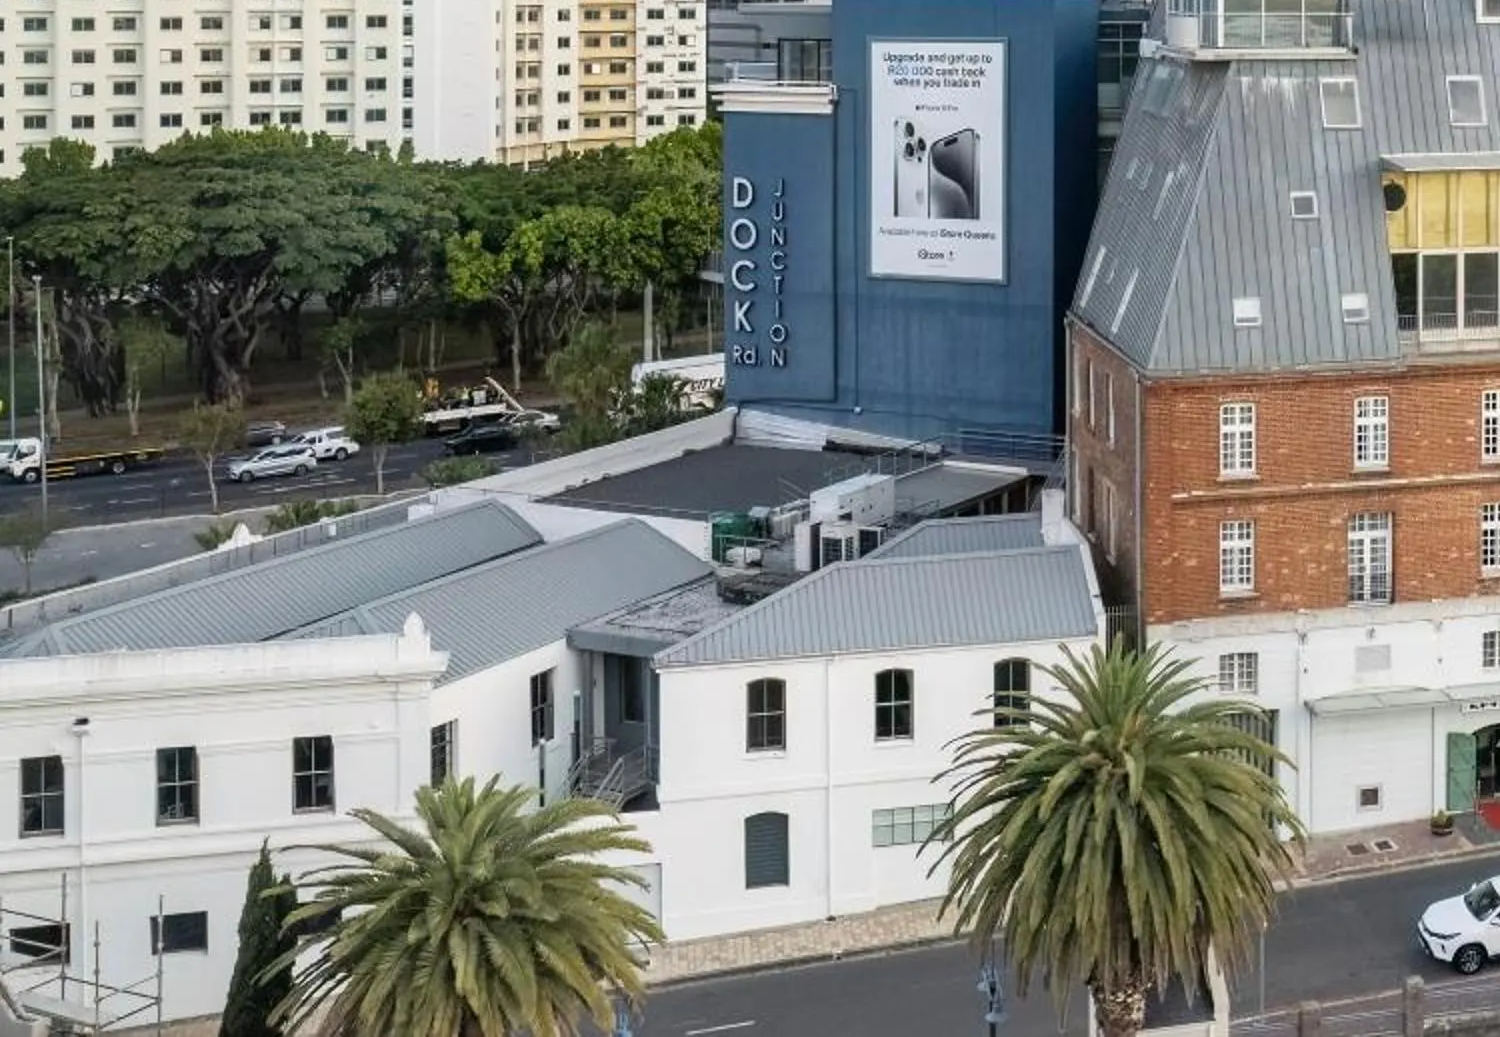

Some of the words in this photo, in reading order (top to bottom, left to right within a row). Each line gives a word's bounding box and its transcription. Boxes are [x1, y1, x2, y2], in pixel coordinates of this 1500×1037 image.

[883, 51, 925, 64] Upgrade
[927, 52, 946, 63] and
[948, 53, 965, 65] get
[966, 54, 980, 65] up
[981, 53, 993, 64] to
[924, 79, 941, 89] you
[731, 177, 757, 332] DOCK
[770, 178, 786, 367] JUNCTION
